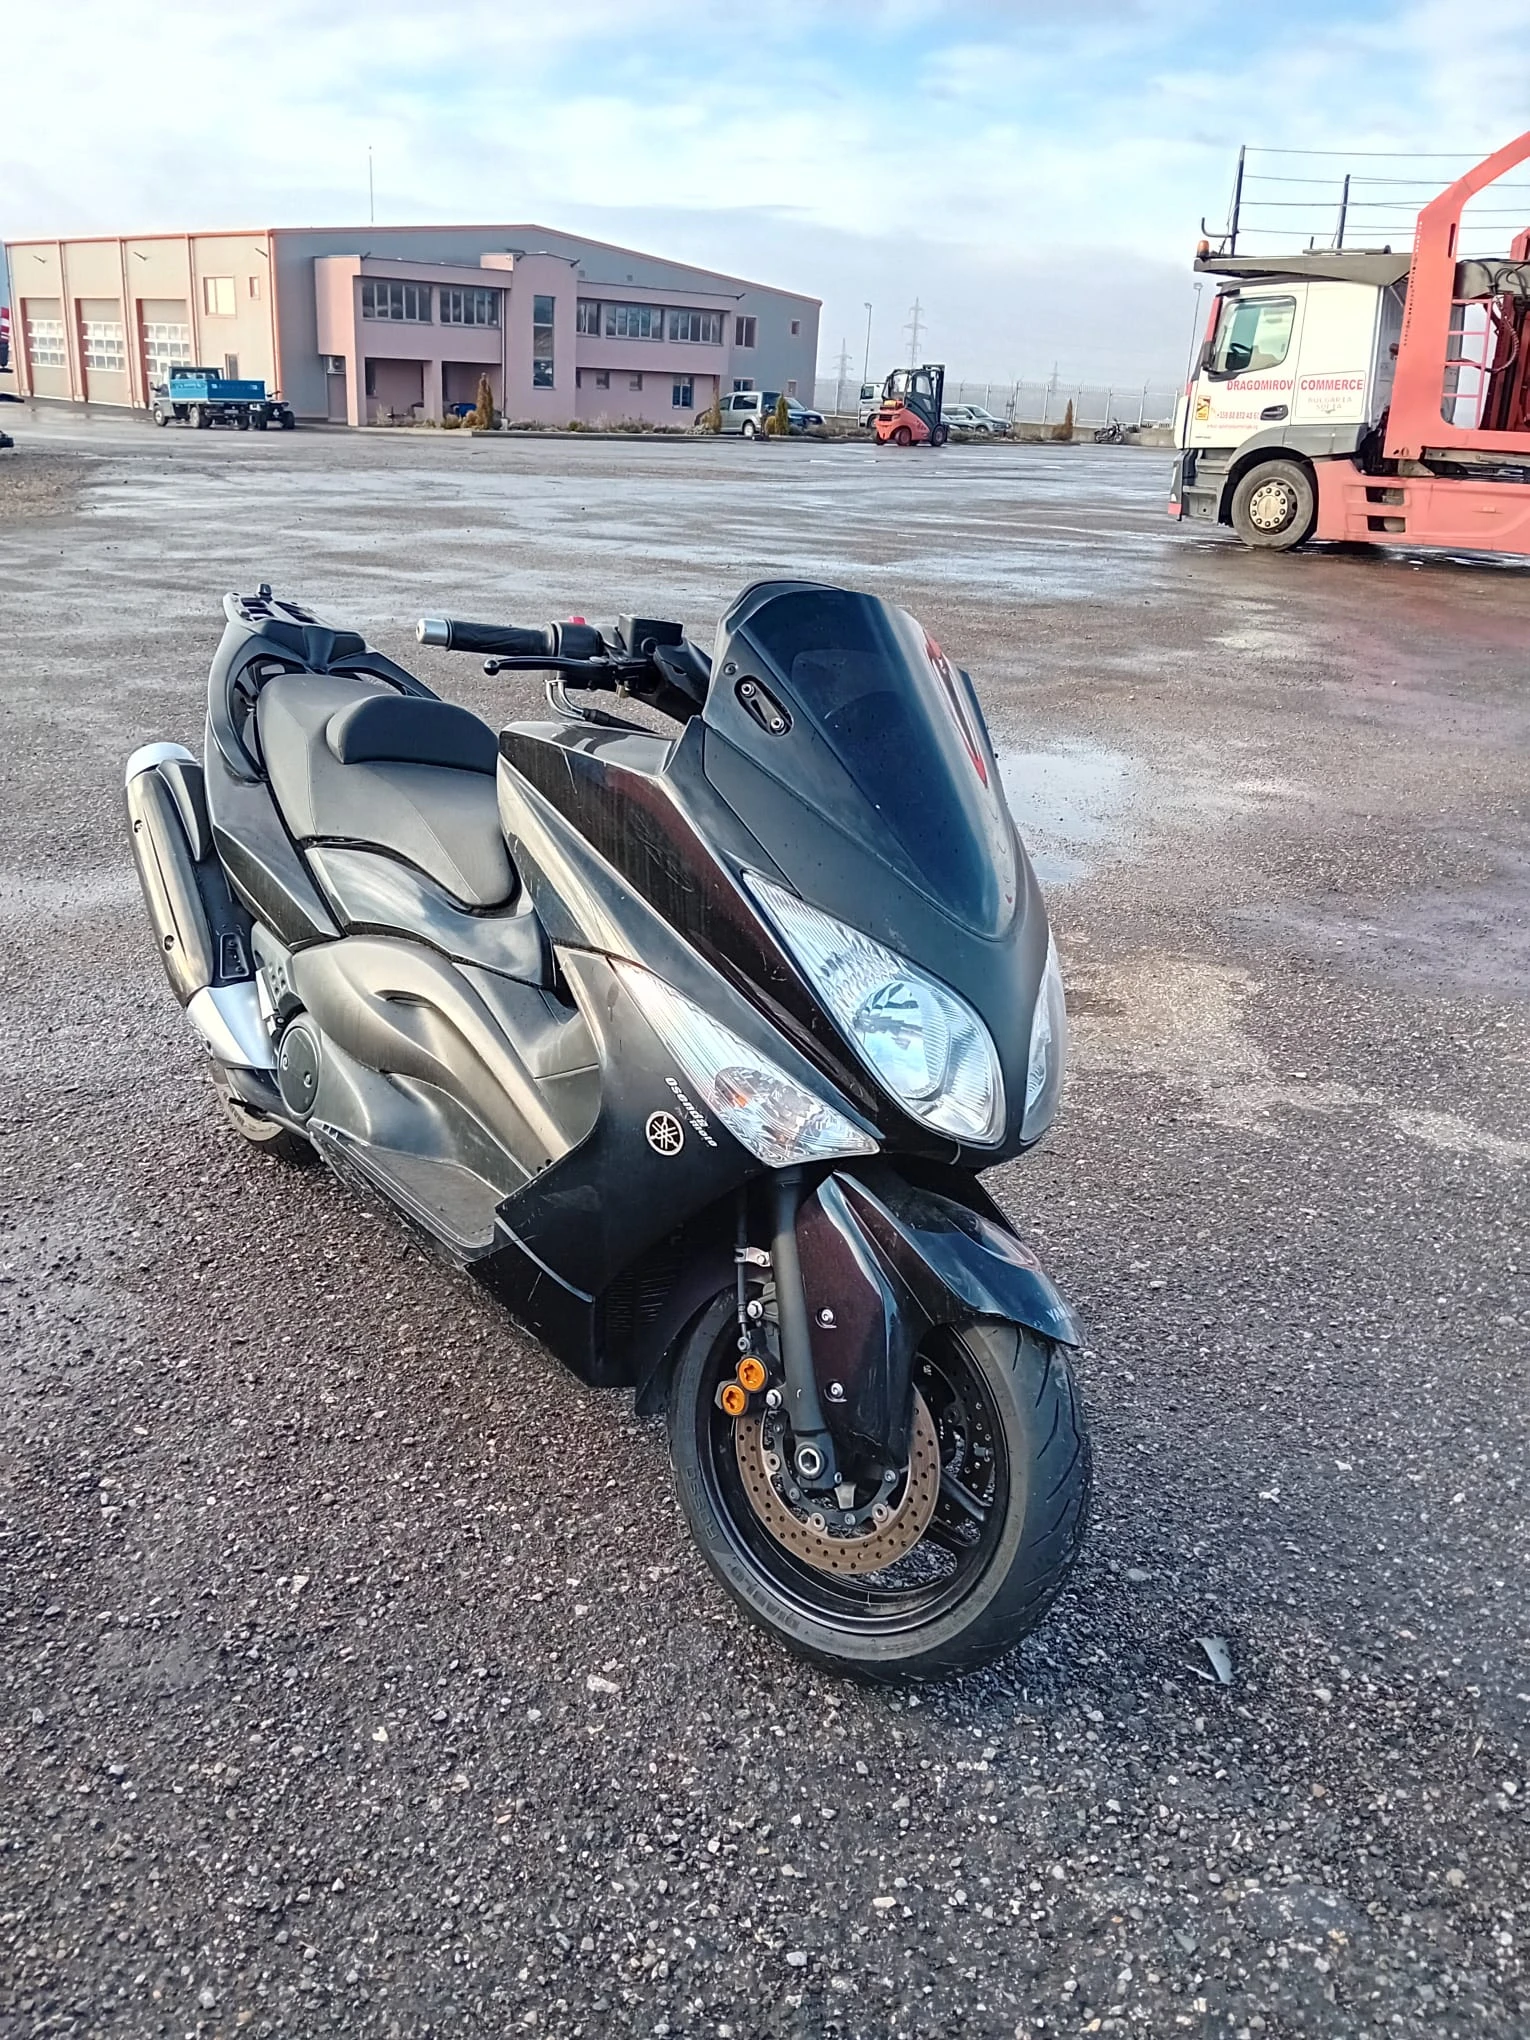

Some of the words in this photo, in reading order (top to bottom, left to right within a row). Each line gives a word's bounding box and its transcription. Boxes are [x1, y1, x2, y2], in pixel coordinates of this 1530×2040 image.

[1227, 379, 1293, 391] DRAGOMIROV
[1301, 379, 1364, 391] COMMERCE
[686, 1465, 715, 1540] ROSSO
[730, 1567, 800, 1631] DIABLO
